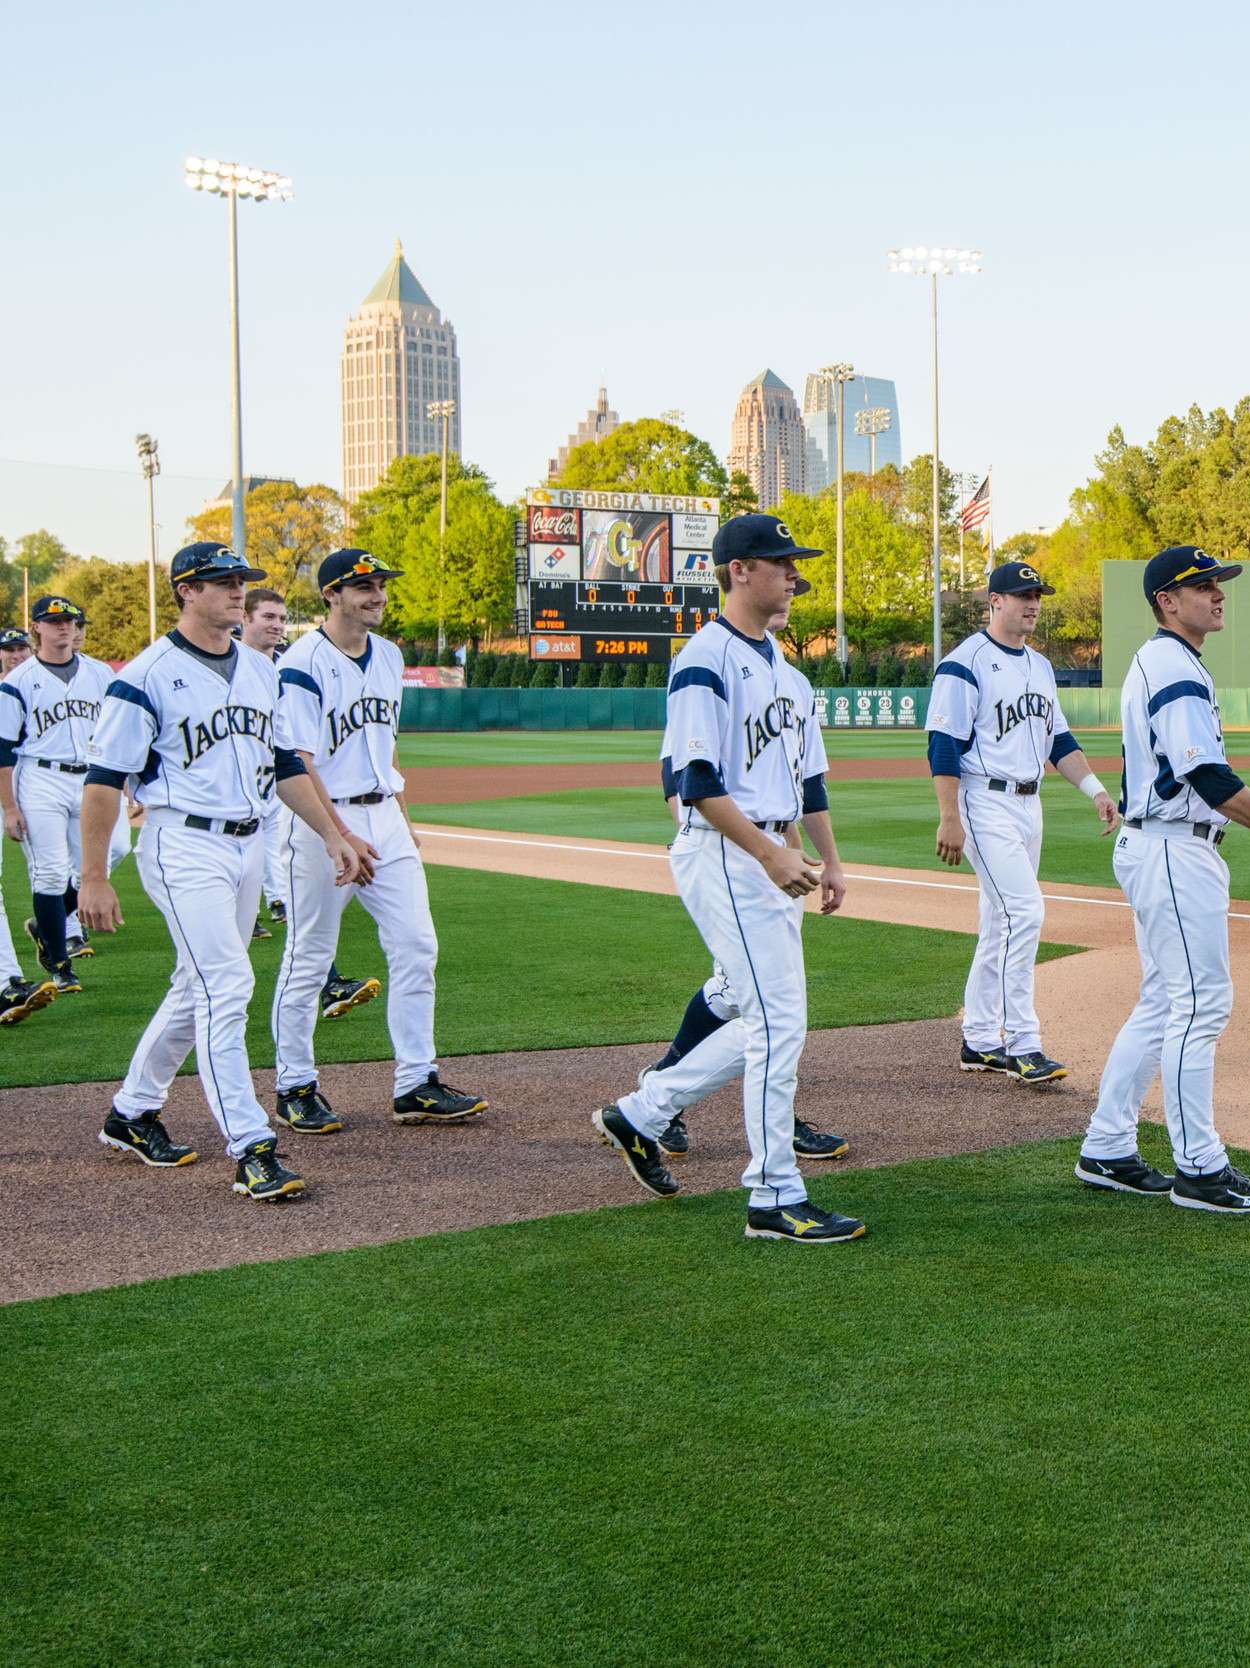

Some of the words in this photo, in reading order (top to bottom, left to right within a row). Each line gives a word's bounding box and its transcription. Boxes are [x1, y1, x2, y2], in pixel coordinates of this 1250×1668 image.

[533, 490, 555, 504] GT
[559, 491, 643, 510] GEORGIA
[648, 496, 696, 512] TECH
[532, 511, 577, 535] Coca-Cola
[684, 523, 707, 531] Medical
[1019, 568, 1039, 582] GT
[589, 589, 597, 603] 0
[627, 590, 635, 604] 0
[665, 591, 673, 605] 0
[542, 609, 559, 618] FSU
[676, 612, 682, 622] 0
[696, 612, 702, 622] 0
[547, 621, 565, 629] TECH
[676, 623, 682, 633] 0
[552, 641, 576, 653] at&t
[596, 640, 625, 654] 7:26
[628, 641, 648, 654] PM
[837, 700, 846, 708] 27
[881, 699, 890, 707] 23
[327, 697, 399, 757] JACKES
[1187, 747, 1203, 759] ACC
